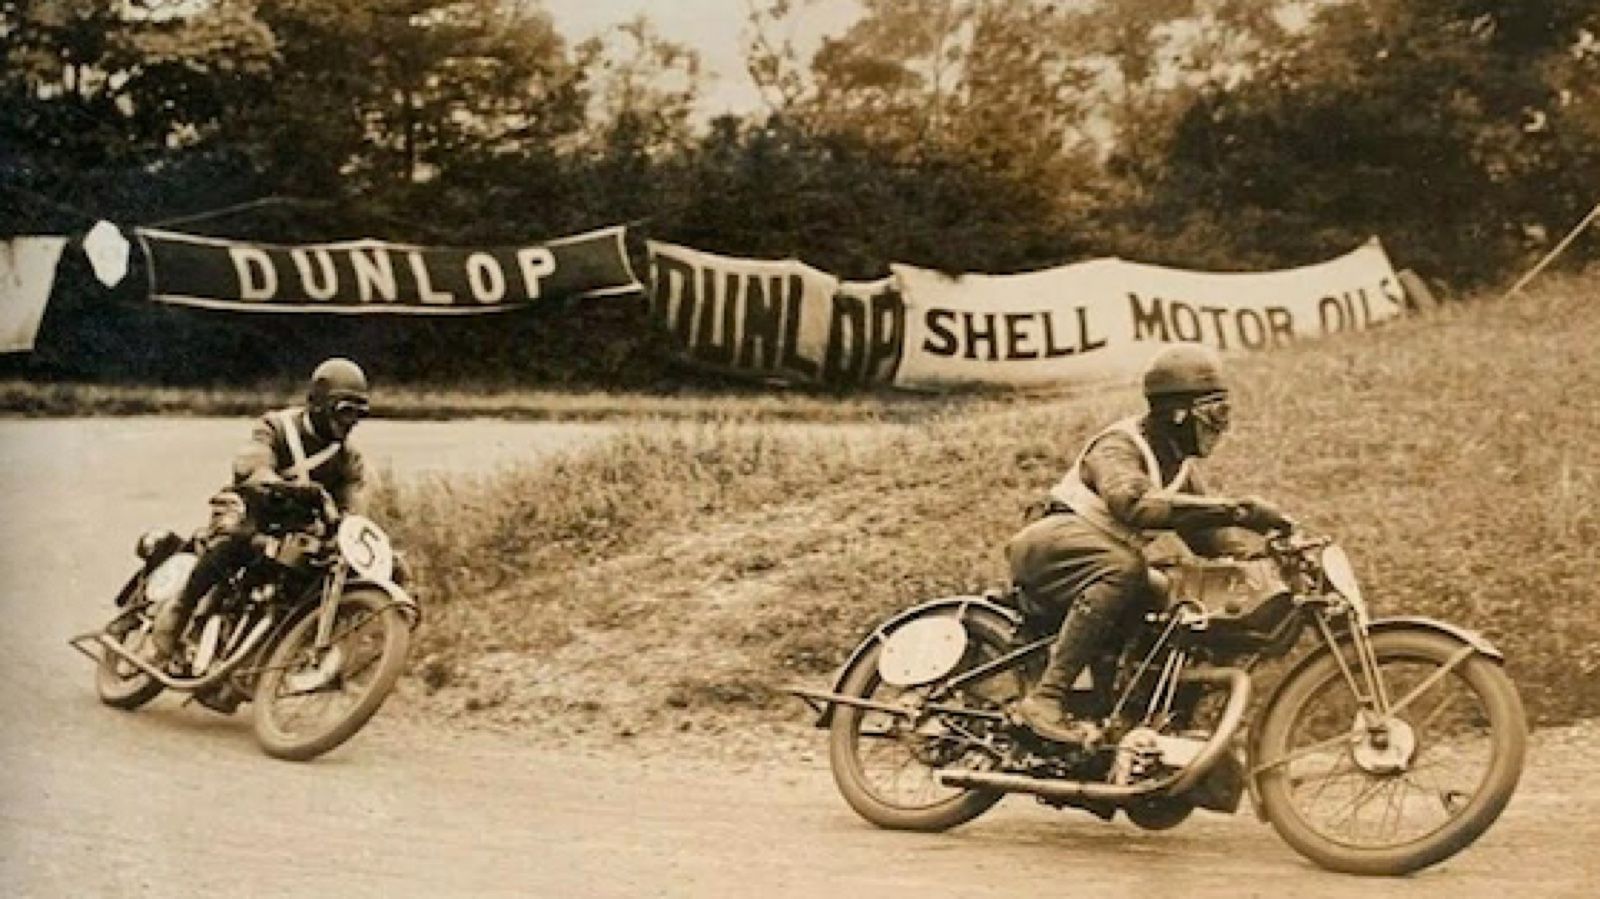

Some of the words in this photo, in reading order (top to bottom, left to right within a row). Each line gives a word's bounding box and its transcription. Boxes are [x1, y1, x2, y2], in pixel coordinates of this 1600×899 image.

[228, 245, 557, 304] DUNLOP
[650, 253, 905, 380] DUNLOP
[923, 306, 1106, 361] SHELL
[1128, 291, 1293, 351] MOTOR
[1318, 278, 1402, 332] OILS
[350, 525, 381, 569] 5
